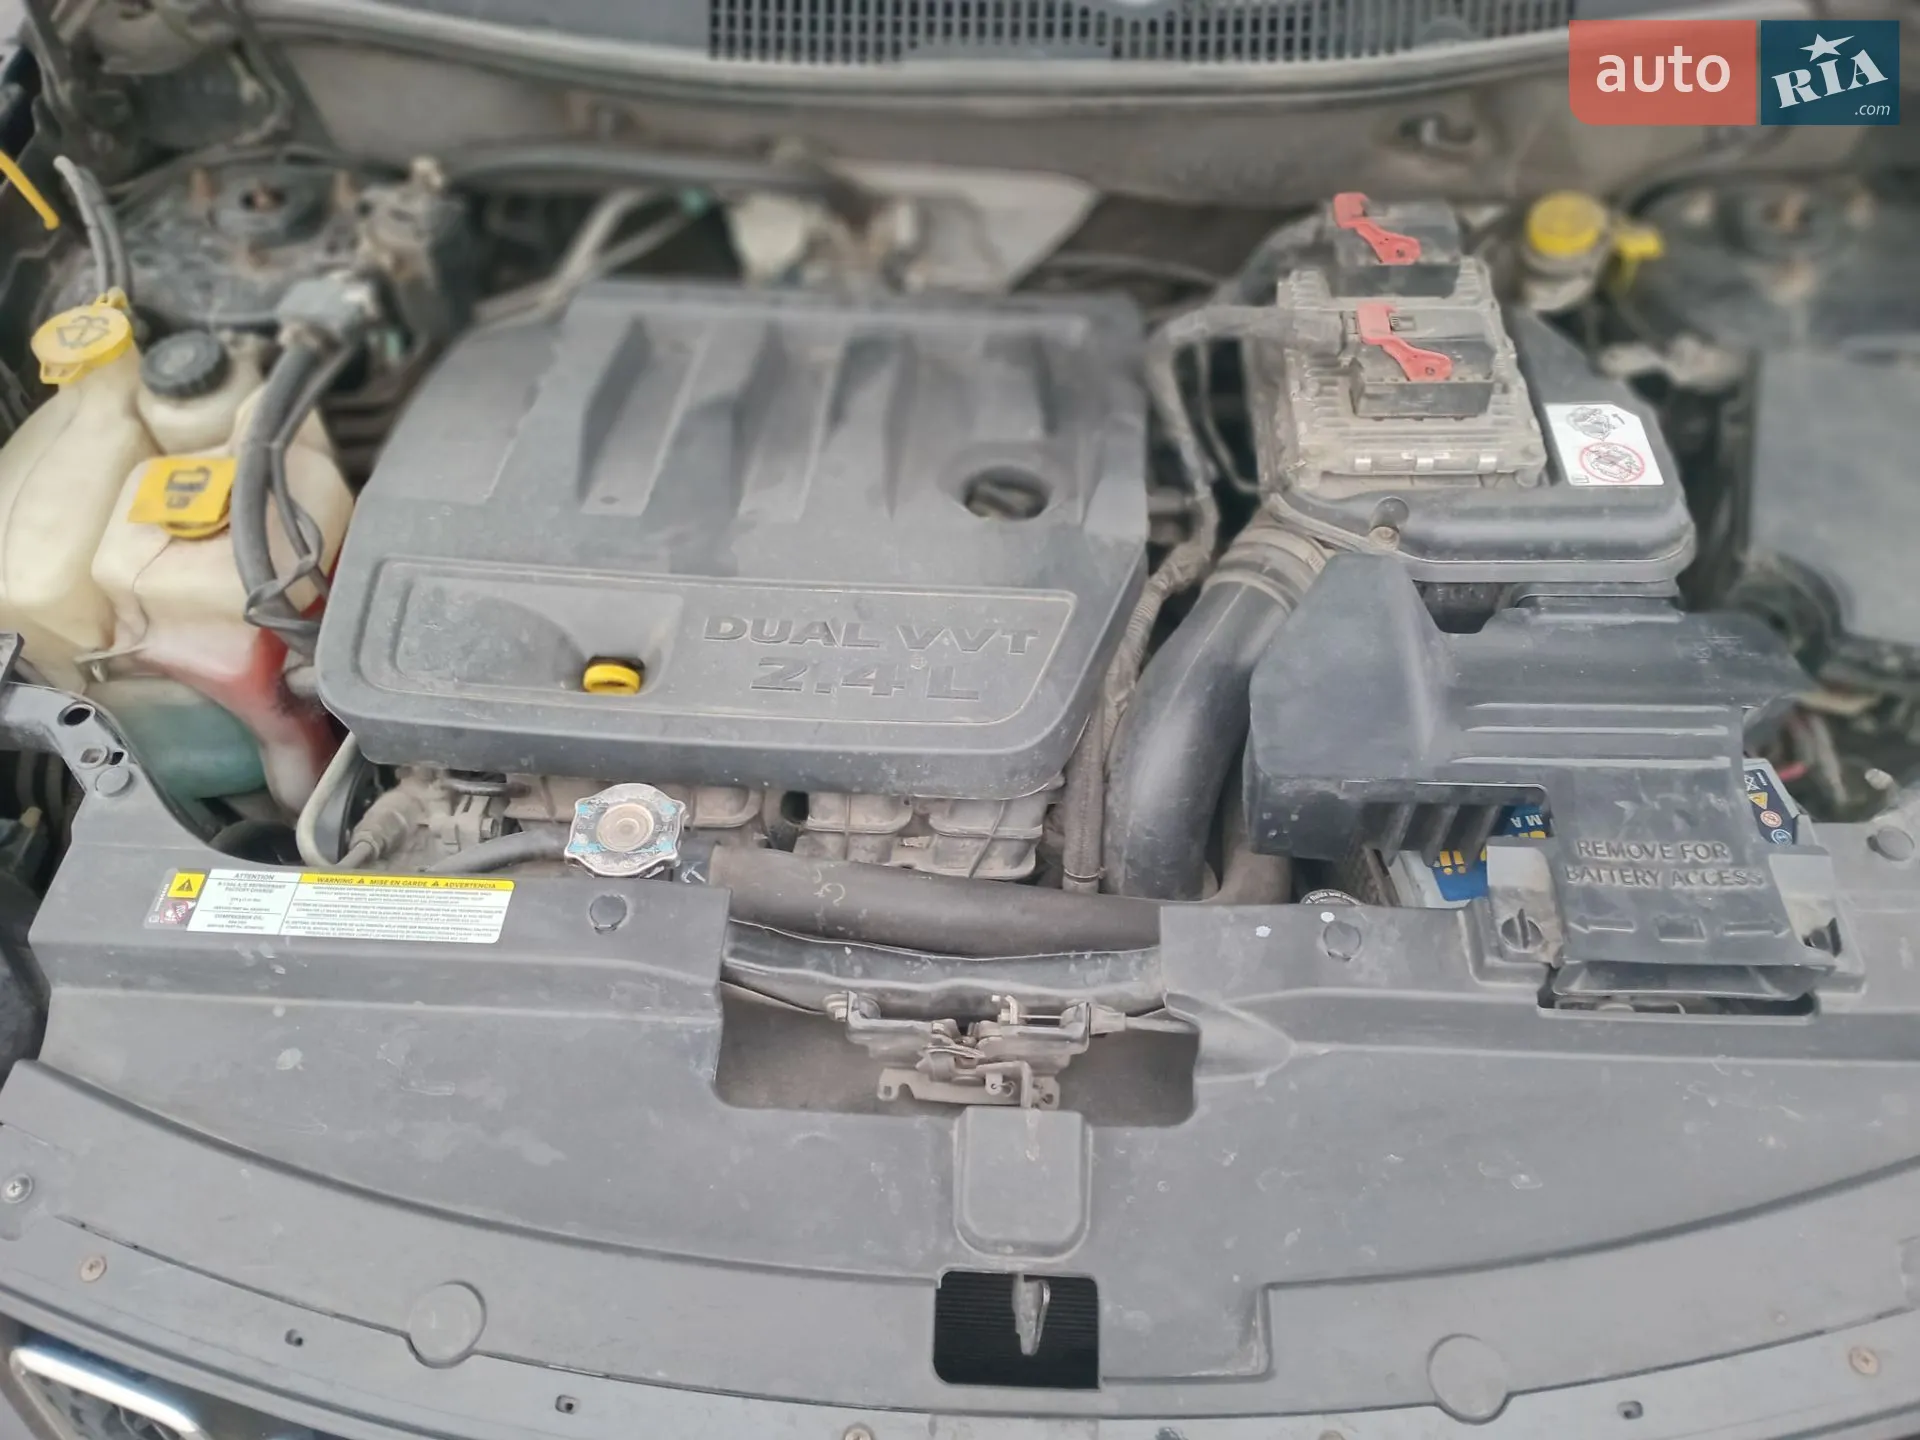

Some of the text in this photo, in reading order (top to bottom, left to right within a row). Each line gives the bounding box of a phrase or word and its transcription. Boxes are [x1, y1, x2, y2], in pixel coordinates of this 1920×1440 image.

[704, 615, 1040, 654] DUAL VVT
[1576, 838, 1732, 862] REMOVE FOR
[233, 873, 276, 881] ATTENTION
[316, 877, 354, 885] WARNING
[1564, 864, 1768, 889] BATTERY ACCESS
[444, 882, 497, 890] ADVERTENCIA
